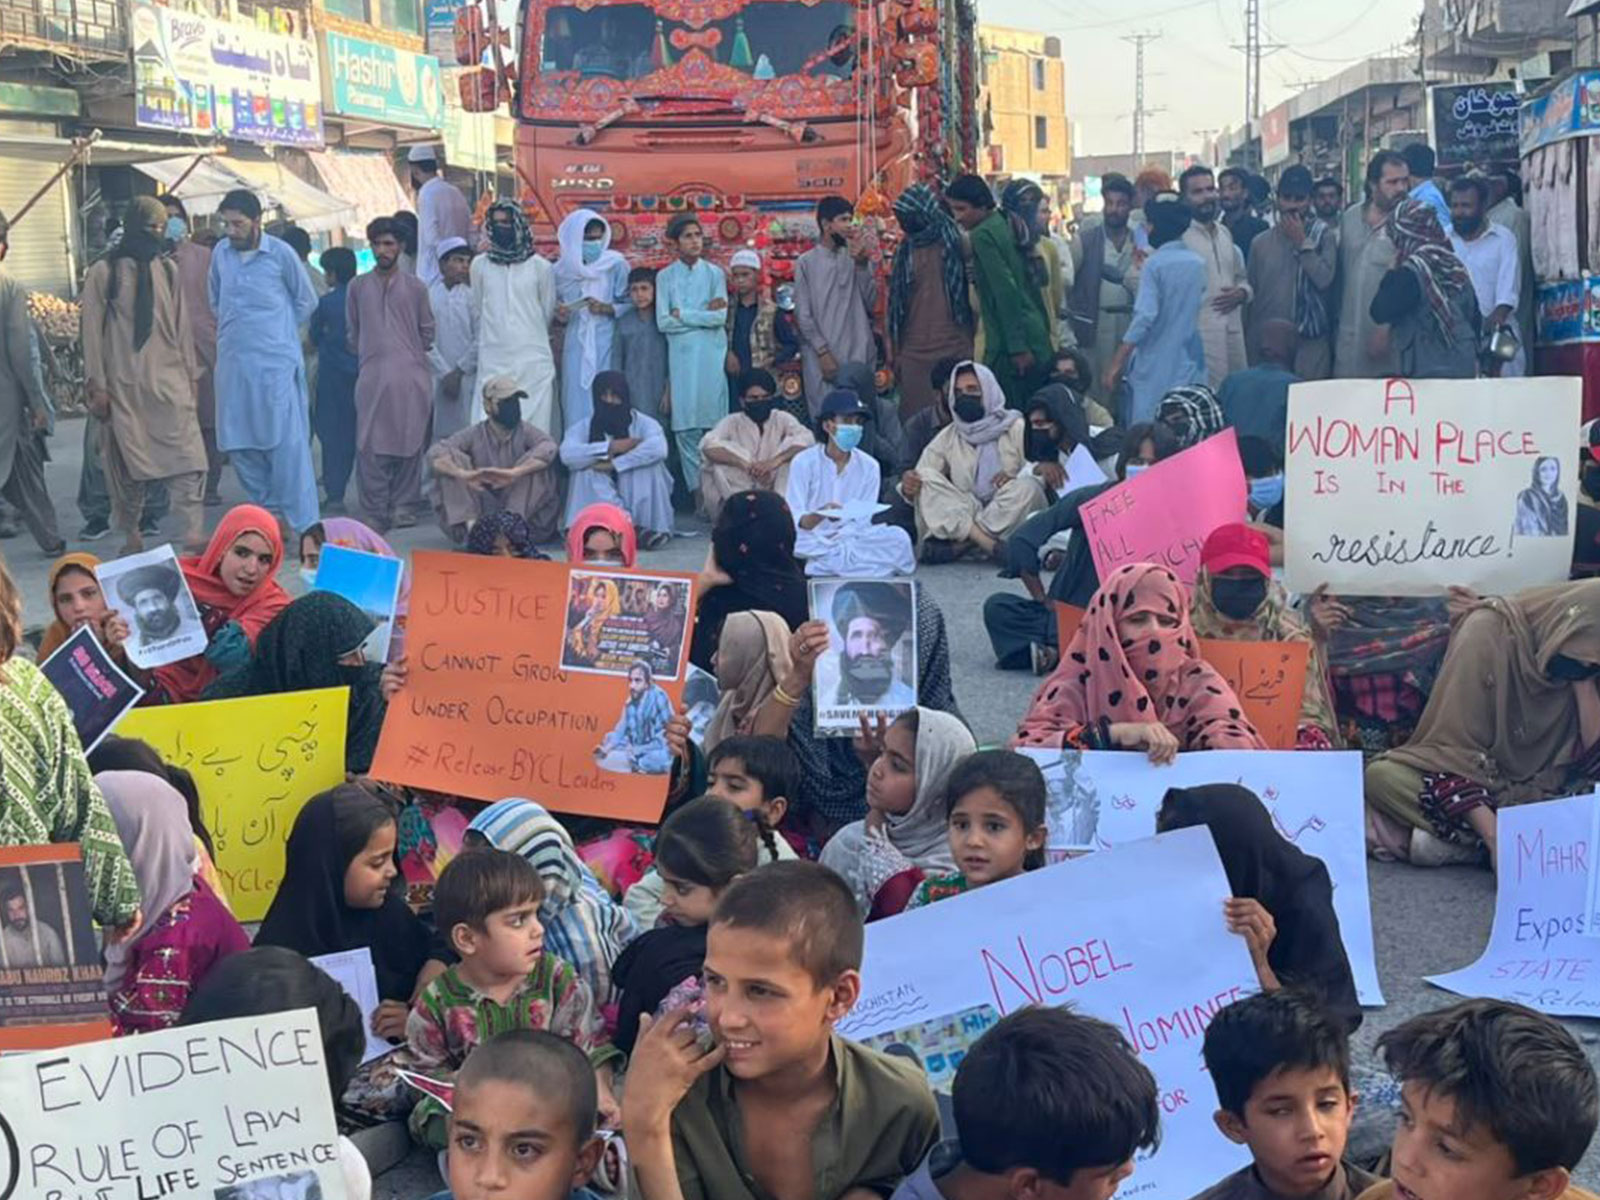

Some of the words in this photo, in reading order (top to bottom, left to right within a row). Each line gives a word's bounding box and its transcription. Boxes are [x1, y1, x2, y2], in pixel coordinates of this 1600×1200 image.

[334, 38, 393, 92] Hashir
[1384, 377, 1414, 415] A
[1289, 416, 1419, 465] WOMAN
[1436, 420, 1541, 464] PLACE
[1314, 470, 1340, 494] IS
[1377, 471, 1405, 493] IN
[1430, 471, 1465, 494] THE
[1086, 490, 1136, 535] FREE
[1096, 535, 1136, 568] ALL
[425, 570, 548, 621] JUSTICE
[420, 642, 500, 673] CANNOT
[512, 654, 568, 683] GROW
[411, 696, 469, 722] UNDER
[486, 694, 598, 733] OCCUPATION
[1517, 828, 1590, 885] MAHR
[216, 867, 277, 896] YCLe
[1515, 907, 1586, 950] Expos
[980, 934, 1134, 1017] NOBEL
[1489, 957, 1593, 982] STATE
[36, 1028, 320, 1113] EVIDENCE
[1157, 1088, 1190, 1113] OR
[30, 1139, 140, 1188] RULE
[152, 1120, 204, 1159] OF
[225, 1104, 301, 1148] LAW
[136, 1168, 200, 1200] LIFE
[217, 1143, 338, 1184] SENTENCE
